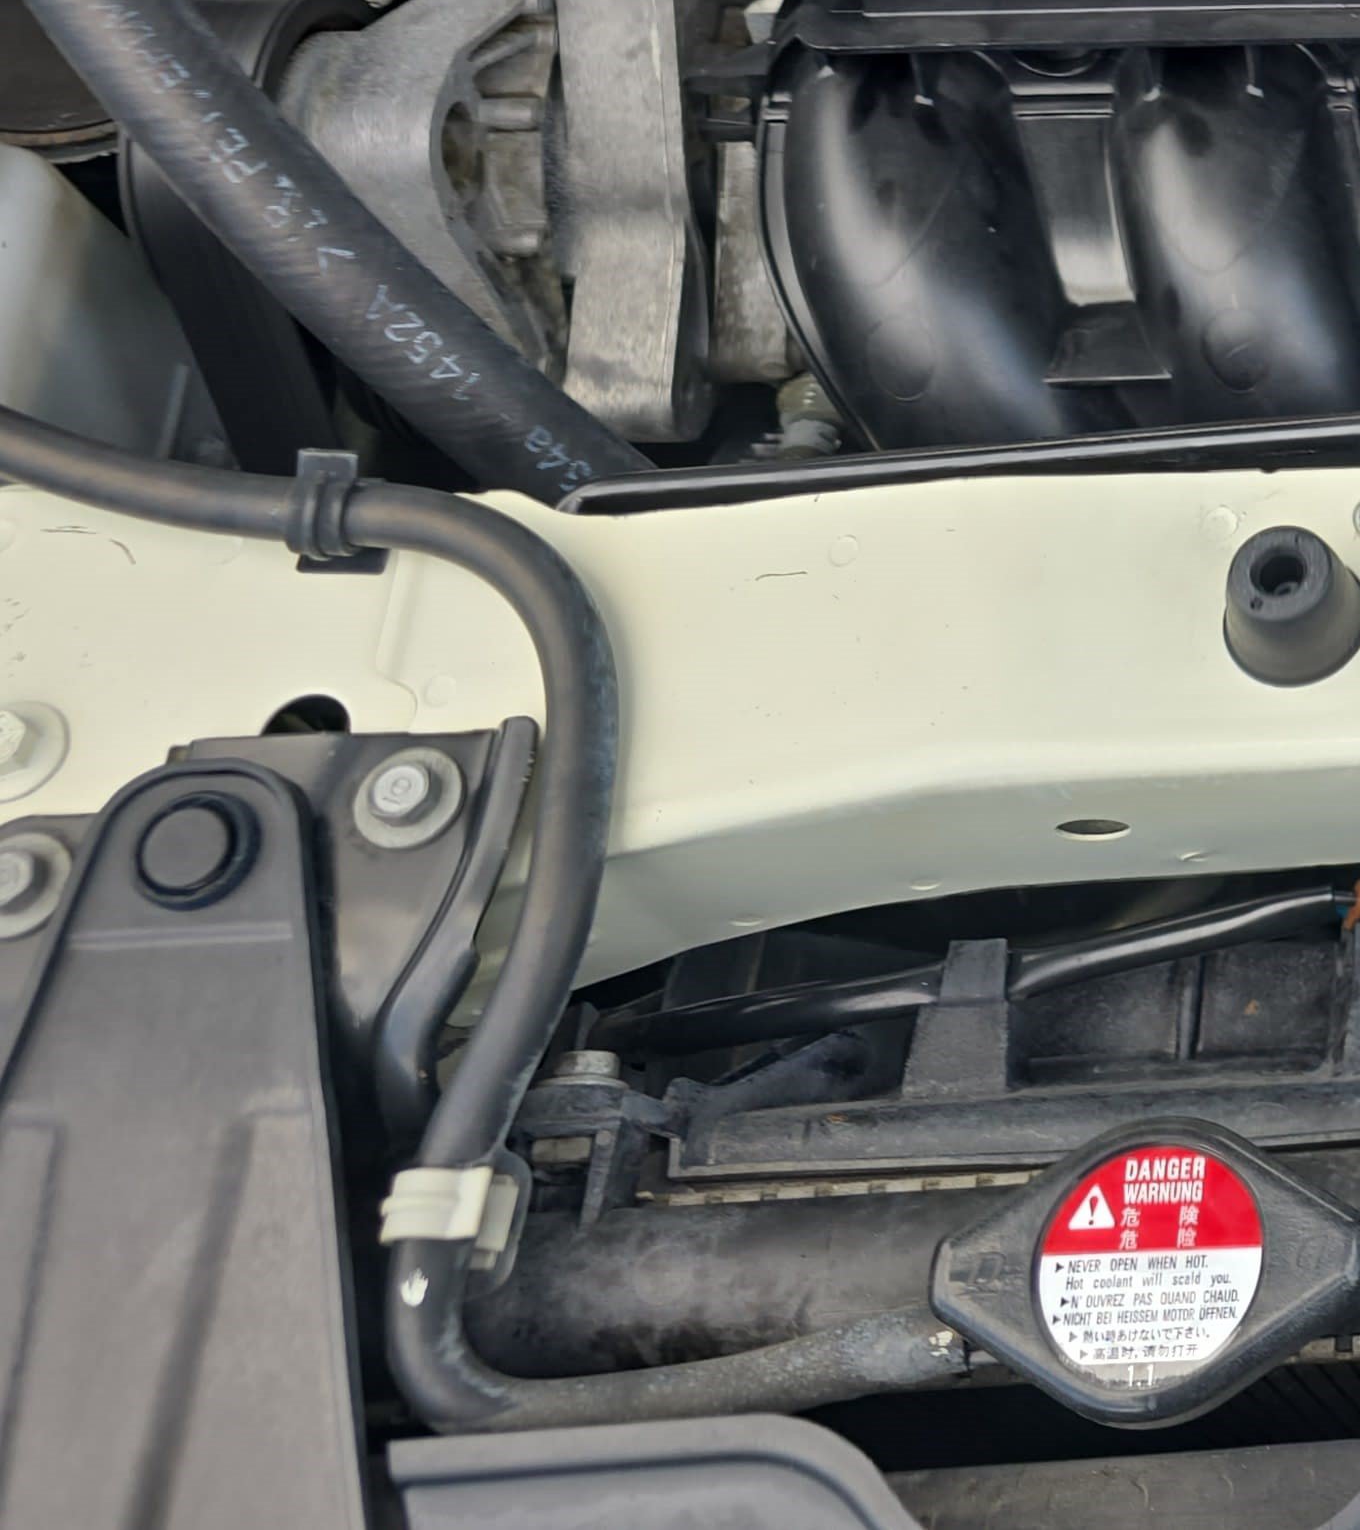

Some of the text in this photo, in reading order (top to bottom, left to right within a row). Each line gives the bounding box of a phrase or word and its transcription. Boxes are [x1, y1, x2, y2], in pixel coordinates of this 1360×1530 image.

[1124, 1156, 1206, 1182] DANGER
[1123, 1181, 1203, 1205] WARNUNG
[1068, 1255, 1208, 1274] NEVER OPEN WHEN HOT.
[1065, 1272, 1232, 1290] Hot coolant will scald you.
[1133, 1292, 1153, 1306] PAS
[1203, 1289, 1240, 1303] CHAUD.
[1063, 1312, 1092, 1326] NICHT
[1096, 1310, 1112, 1325] BEI
[1117, 1309, 1158, 1324] HEISSEM
[1163, 1308, 1195, 1322] MOTOR
